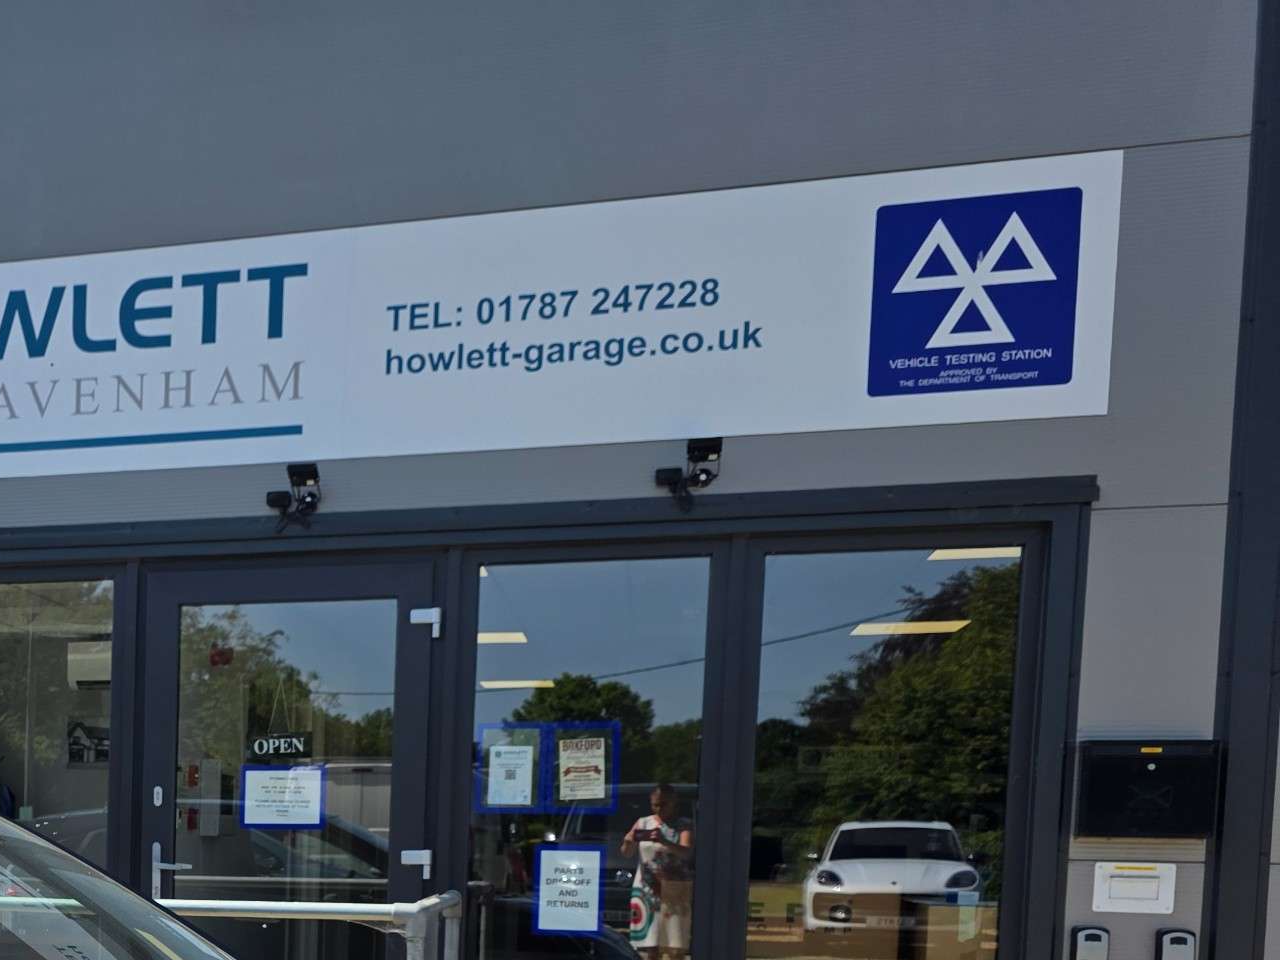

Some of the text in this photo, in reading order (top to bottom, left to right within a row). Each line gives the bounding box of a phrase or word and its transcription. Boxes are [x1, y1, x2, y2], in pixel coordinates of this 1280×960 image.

[386, 278, 720, 331] TEL: 01787 247228
[385, 321, 763, 375] howlett-garage.co.uk
[889, 348, 1053, 369] VEHICLE TESTING STATION
[899, 371, 1039, 388] THE DEPARTMENT OF TRANSPORT
[939, 367, 998, 377] APPROVED BY
[253, 737, 305, 755] OPEN
[558, 889, 578, 898] AND
[546, 900, 590, 909] RETURNS
